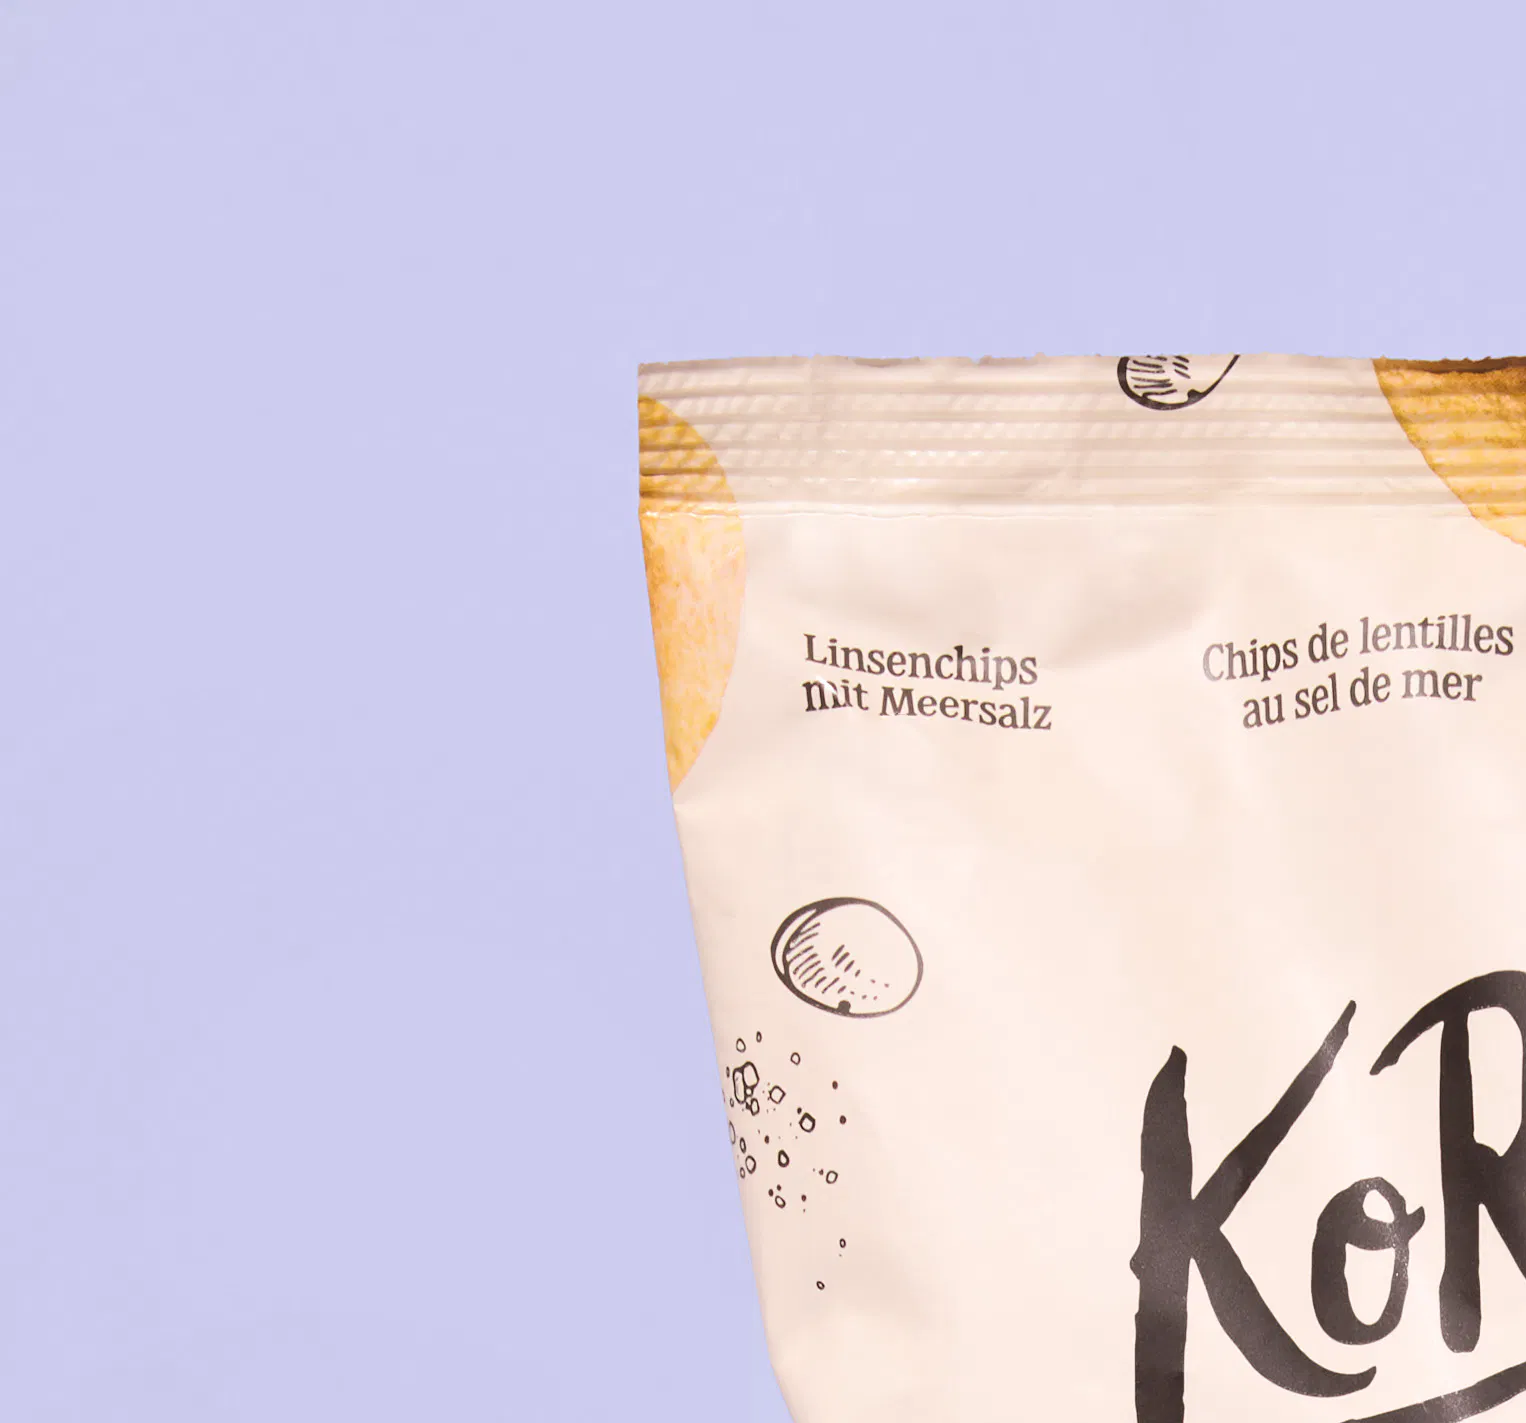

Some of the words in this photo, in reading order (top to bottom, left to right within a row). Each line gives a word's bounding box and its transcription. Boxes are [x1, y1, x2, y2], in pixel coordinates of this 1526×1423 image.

[803, 633, 1038, 690] Linsenchips
[1203, 638, 1299, 682] Chips
[1308, 622, 1349, 664] de
[1359, 614, 1514, 656] lentilles
[802, 678, 869, 712] mit
[880, 686, 1052, 730] Meersalz
[1242, 693, 1285, 729] au
[1295, 672, 1341, 719] sel
[1350, 667, 1391, 708] de
[1402, 668, 1483, 701] mer
